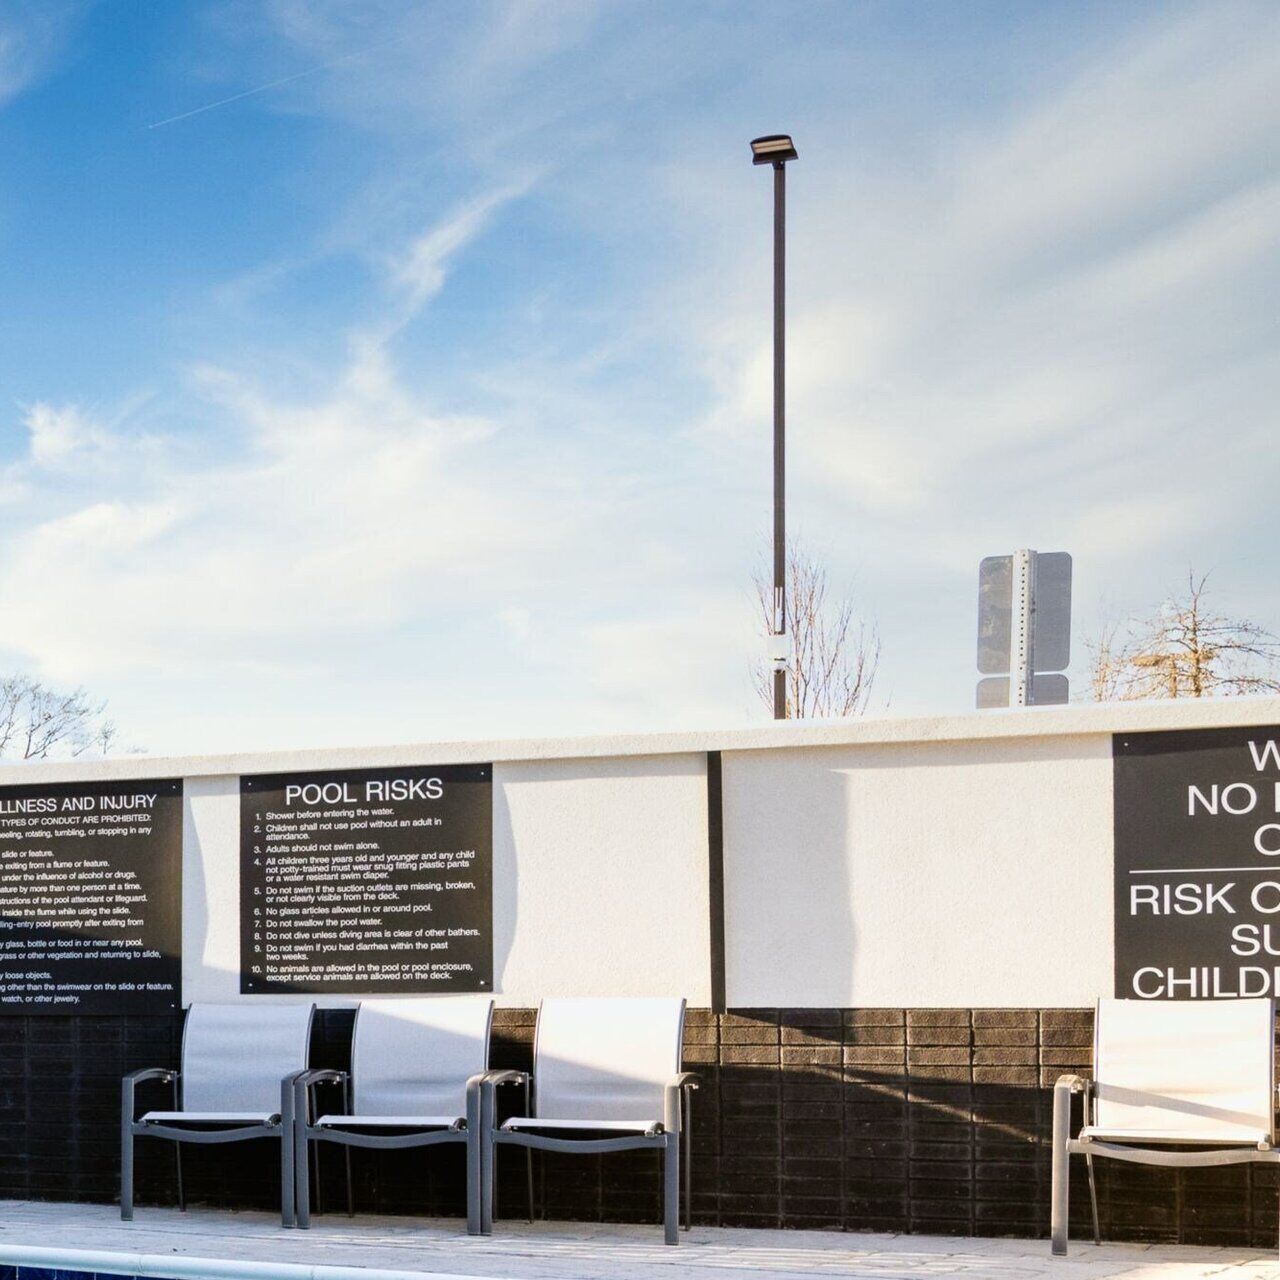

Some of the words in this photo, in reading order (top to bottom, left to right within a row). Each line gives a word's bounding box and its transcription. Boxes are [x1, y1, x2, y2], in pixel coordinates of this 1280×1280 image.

[285, 781, 357, 805] POOL
[363, 777, 442, 801] RISKS
[61, 796, 95, 811] AND
[99, 794, 156, 809] INJURY
[1188, 782, 1257, 816] NO
[0, 818, 26, 826] TYPES
[27, 817, 39, 825] OF
[40, 816, 80, 825] CONDUCT
[82, 815, 99, 823] ARE
[100, 813, 151, 823] PROHIBITED:
[265, 811, 294, 819] Shower
[296, 810, 321, 818] before
[322, 809, 354, 818] entering
[356, 808, 369, 816] the
[265, 824, 297, 832] Children
[319, 822, 331, 830] not
[350, 821, 367, 830] pool
[369, 820, 398, 828] without
[412, 818, 432, 826] adult
[333, 842, 354, 850] swim
[336, 884, 365, 892] suction
[366, 883, 393, 891] outlets
[289, 894, 315, 903] clearly
[316, 893, 341, 901] visible
[1130, 883, 1236, 916] RISK
[279, 907, 299, 915] glass
[301, 906, 329, 914] articles
[331, 905, 361, 913] allowed
[382, 904, 411, 912] around
[325, 918, 338, 926] the
[339, 918, 357, 927] pool
[293, 931, 309, 939] dive
[338, 930, 362, 939] diving
[392, 929, 413, 937] clear
[1132, 966, 1280, 999] CHILD
